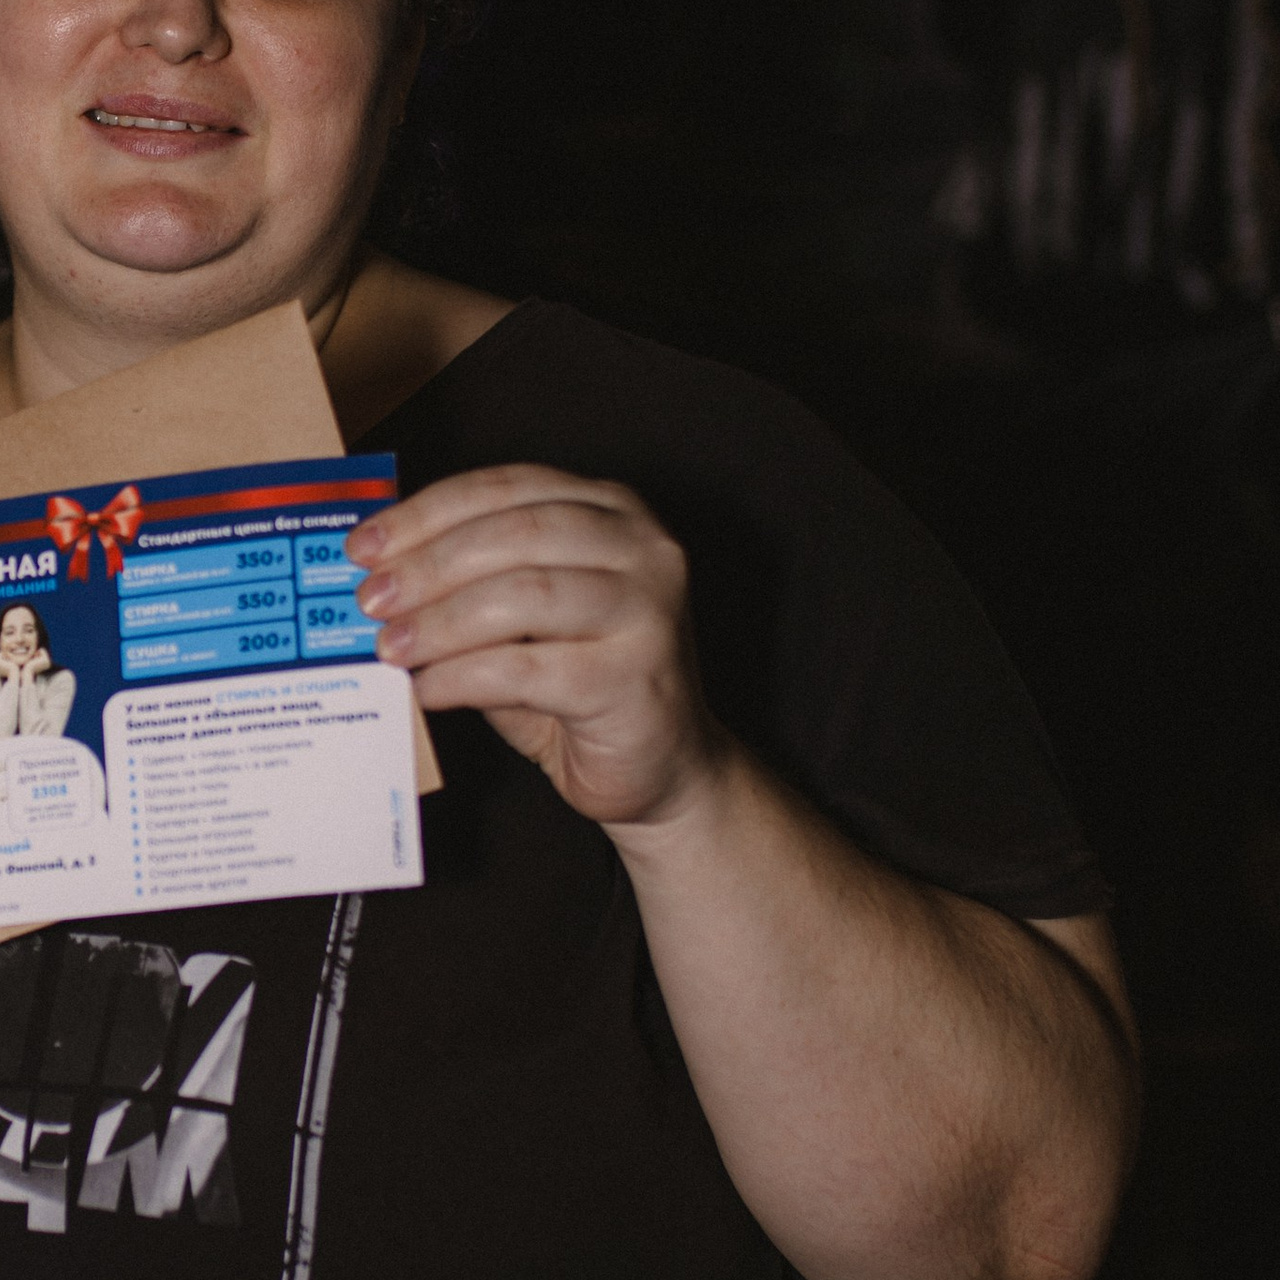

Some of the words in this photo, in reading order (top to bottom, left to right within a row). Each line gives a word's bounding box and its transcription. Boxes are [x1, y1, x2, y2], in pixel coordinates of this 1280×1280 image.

[138, 524, 232, 548] Стандартные
[234, 521, 273, 536] цены
[275, 516, 301, 531] без
